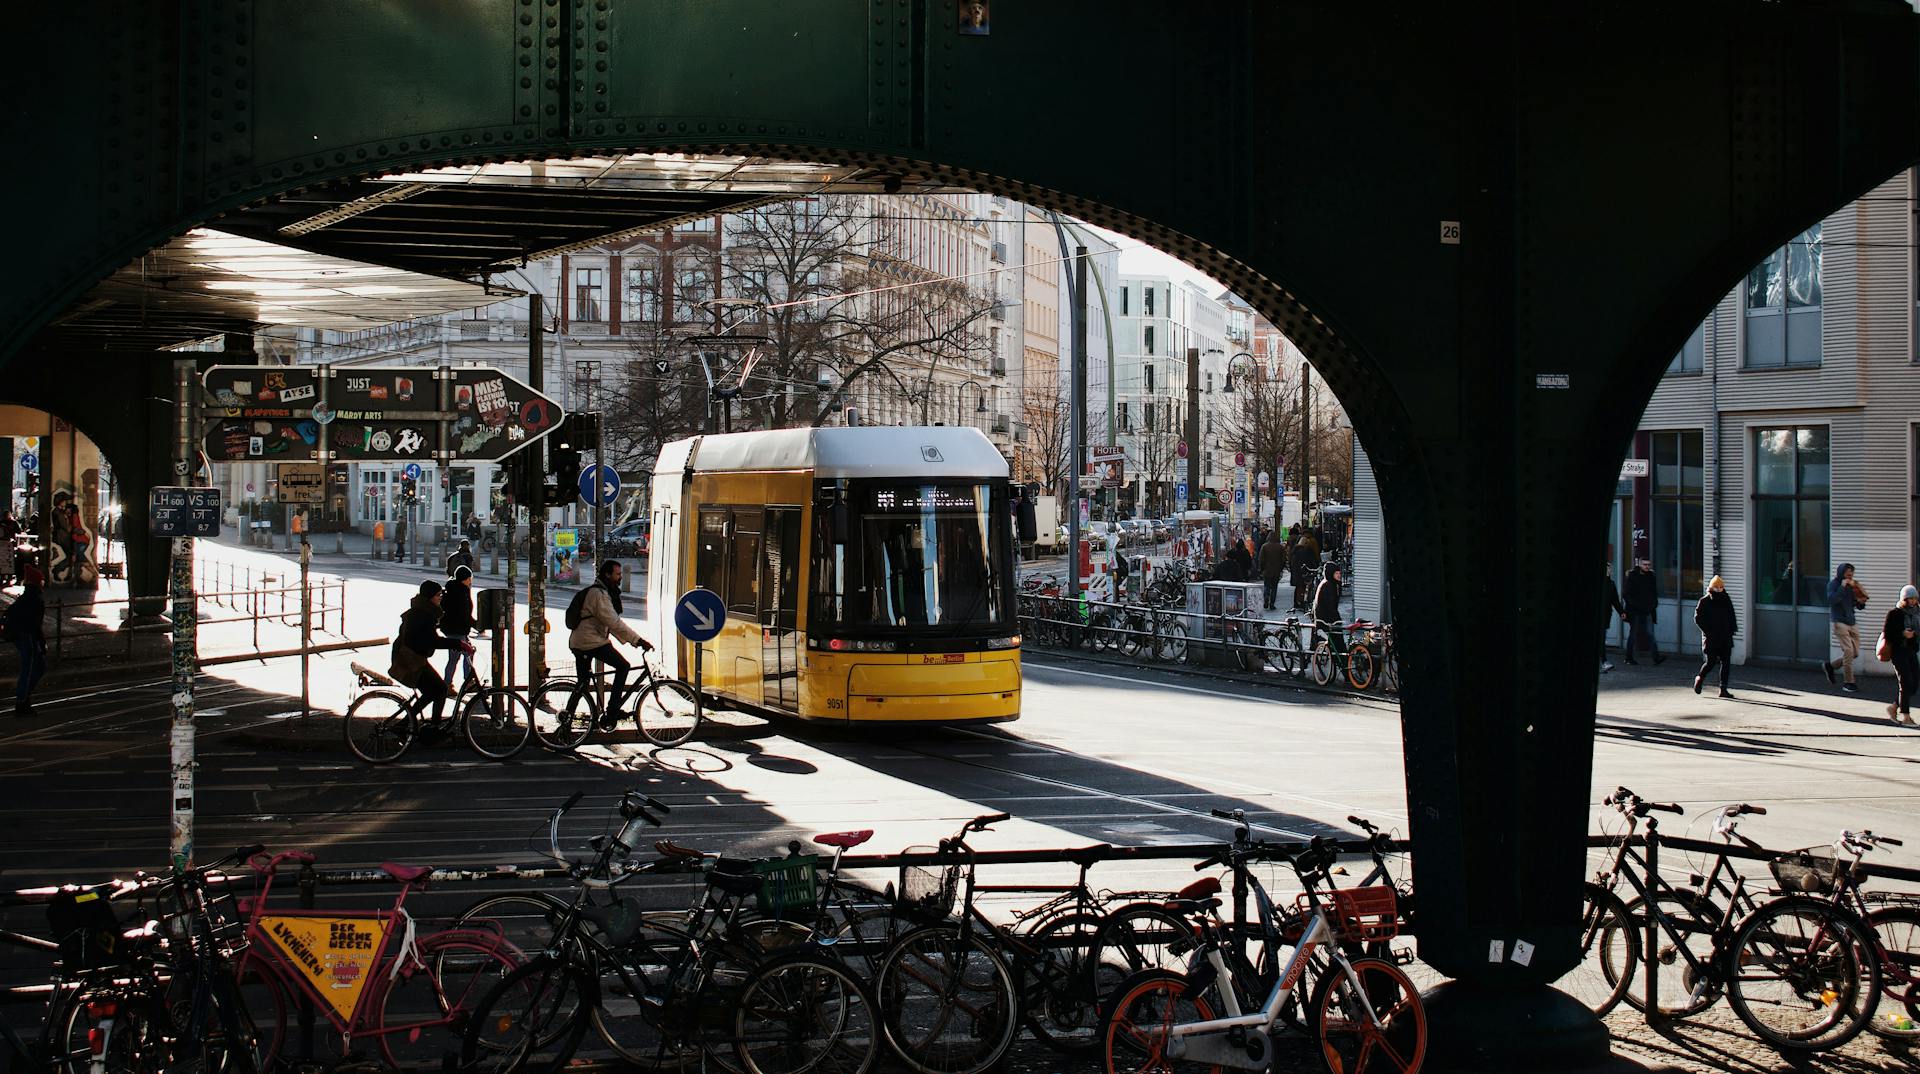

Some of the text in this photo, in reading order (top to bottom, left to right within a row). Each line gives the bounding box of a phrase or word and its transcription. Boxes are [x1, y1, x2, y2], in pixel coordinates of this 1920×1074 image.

[1444, 226, 1458, 239] 26
[346, 378, 371, 389] JUST
[473, 379, 504, 398] MISS
[337, 410, 382, 420] MARDY ARTS
[153, 494, 169, 505] LH
[188, 494, 204, 506] VS
[827, 698, 844, 709] 9051
[331, 923, 355, 932] DER
[273, 922, 318, 969] LYCHENER
[1286, 947, 1309, 985] mobike
